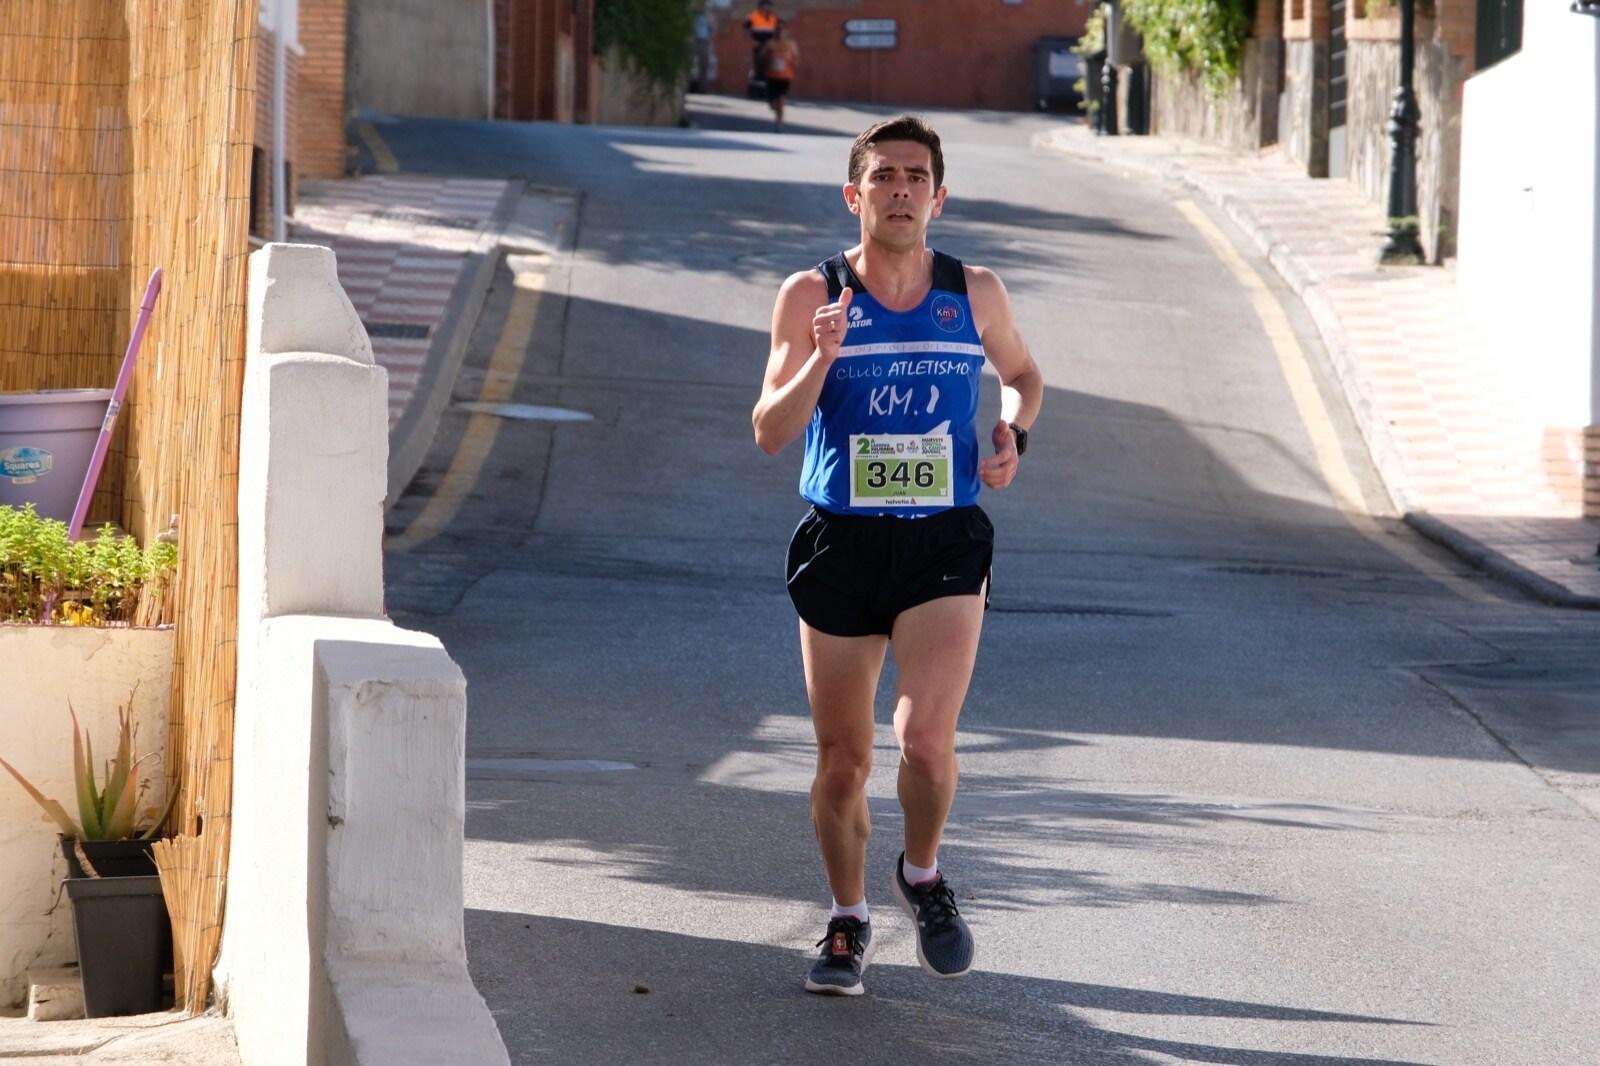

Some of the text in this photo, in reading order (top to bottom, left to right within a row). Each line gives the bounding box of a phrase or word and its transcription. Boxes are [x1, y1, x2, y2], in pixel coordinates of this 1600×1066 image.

[847, 318, 872, 329] IATOR
[888, 360, 969, 377] ATLETISMO
[4, 461, 40, 472] Squares
[867, 462, 934, 488] 346
